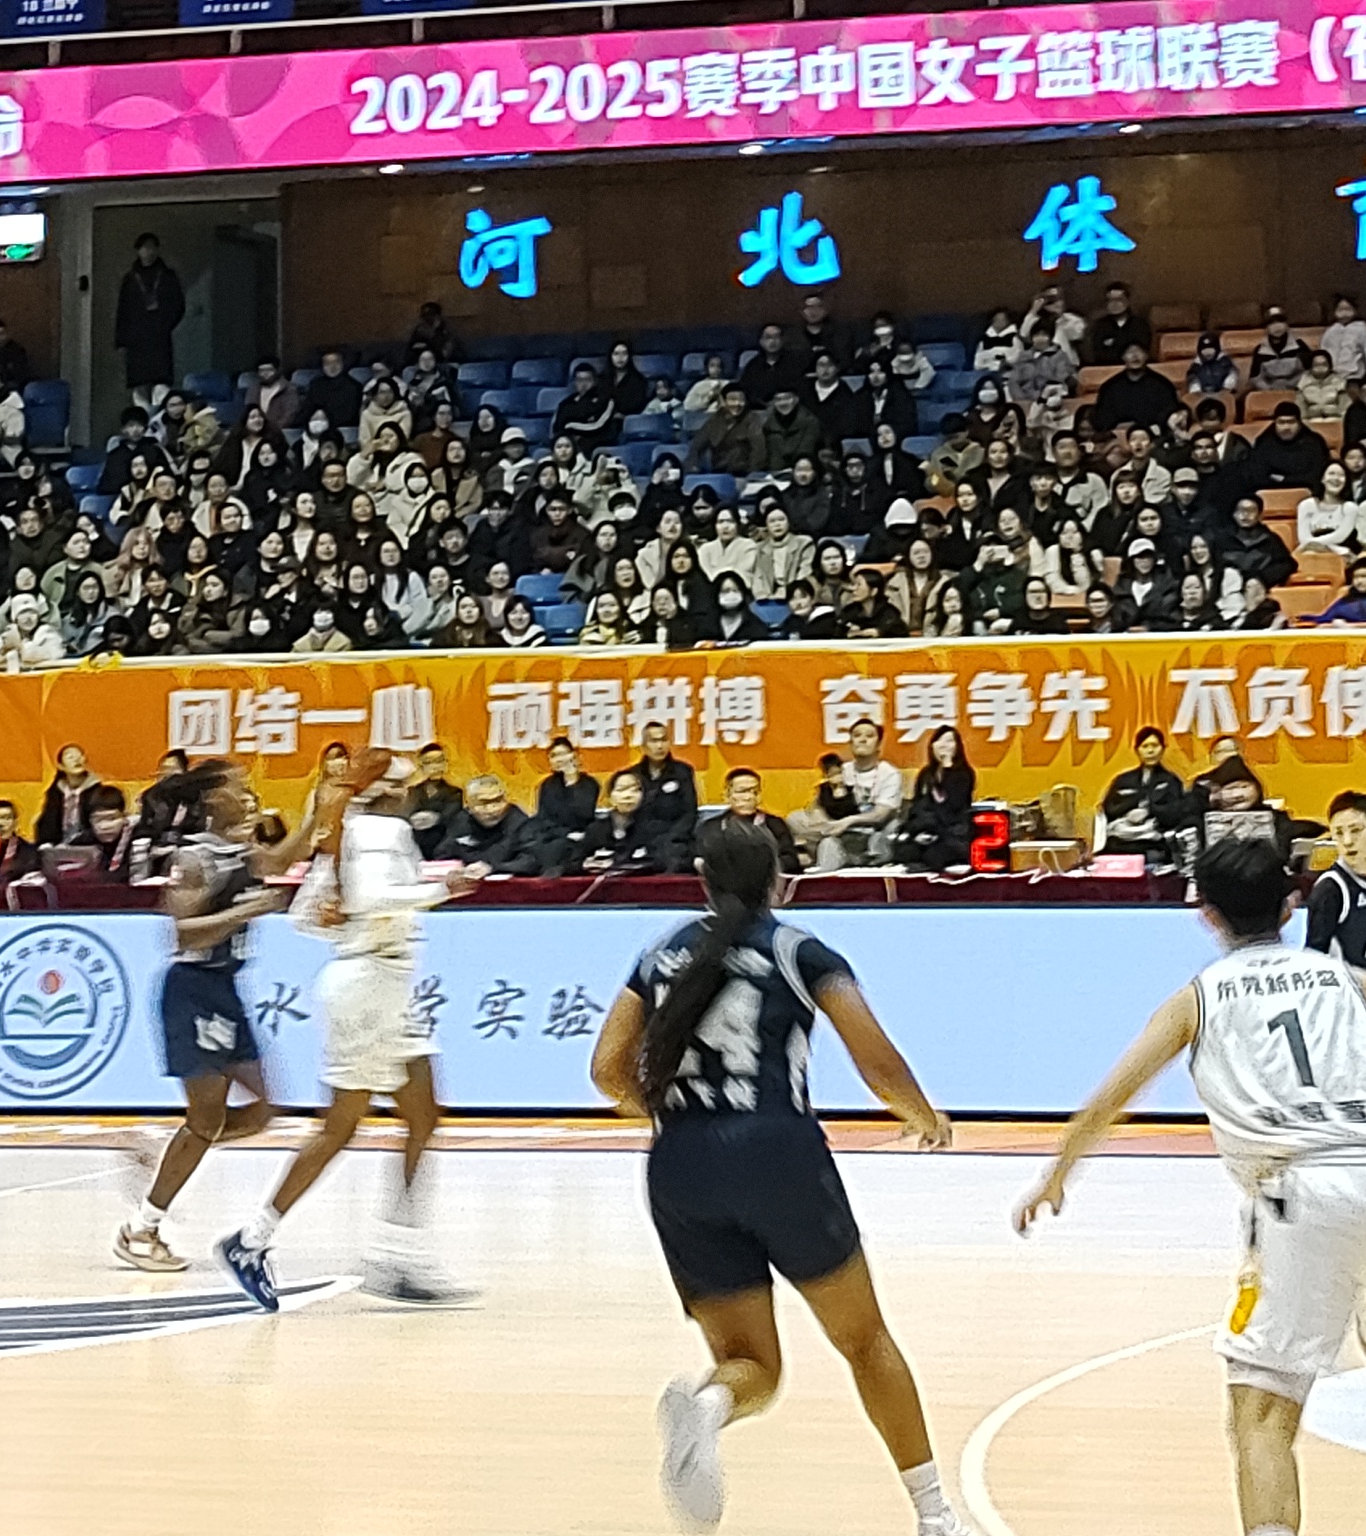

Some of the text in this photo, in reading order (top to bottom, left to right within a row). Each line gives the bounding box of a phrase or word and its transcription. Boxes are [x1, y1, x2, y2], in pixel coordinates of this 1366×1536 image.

[167, 685, 433, 755] 团结一心
[486, 675, 766, 750] 顽强拼搏
[819, 670, 1113, 743] 奋勇争先
[969, 811, 1011, 872] 2
[1267, 1008, 1318, 1088] 1
